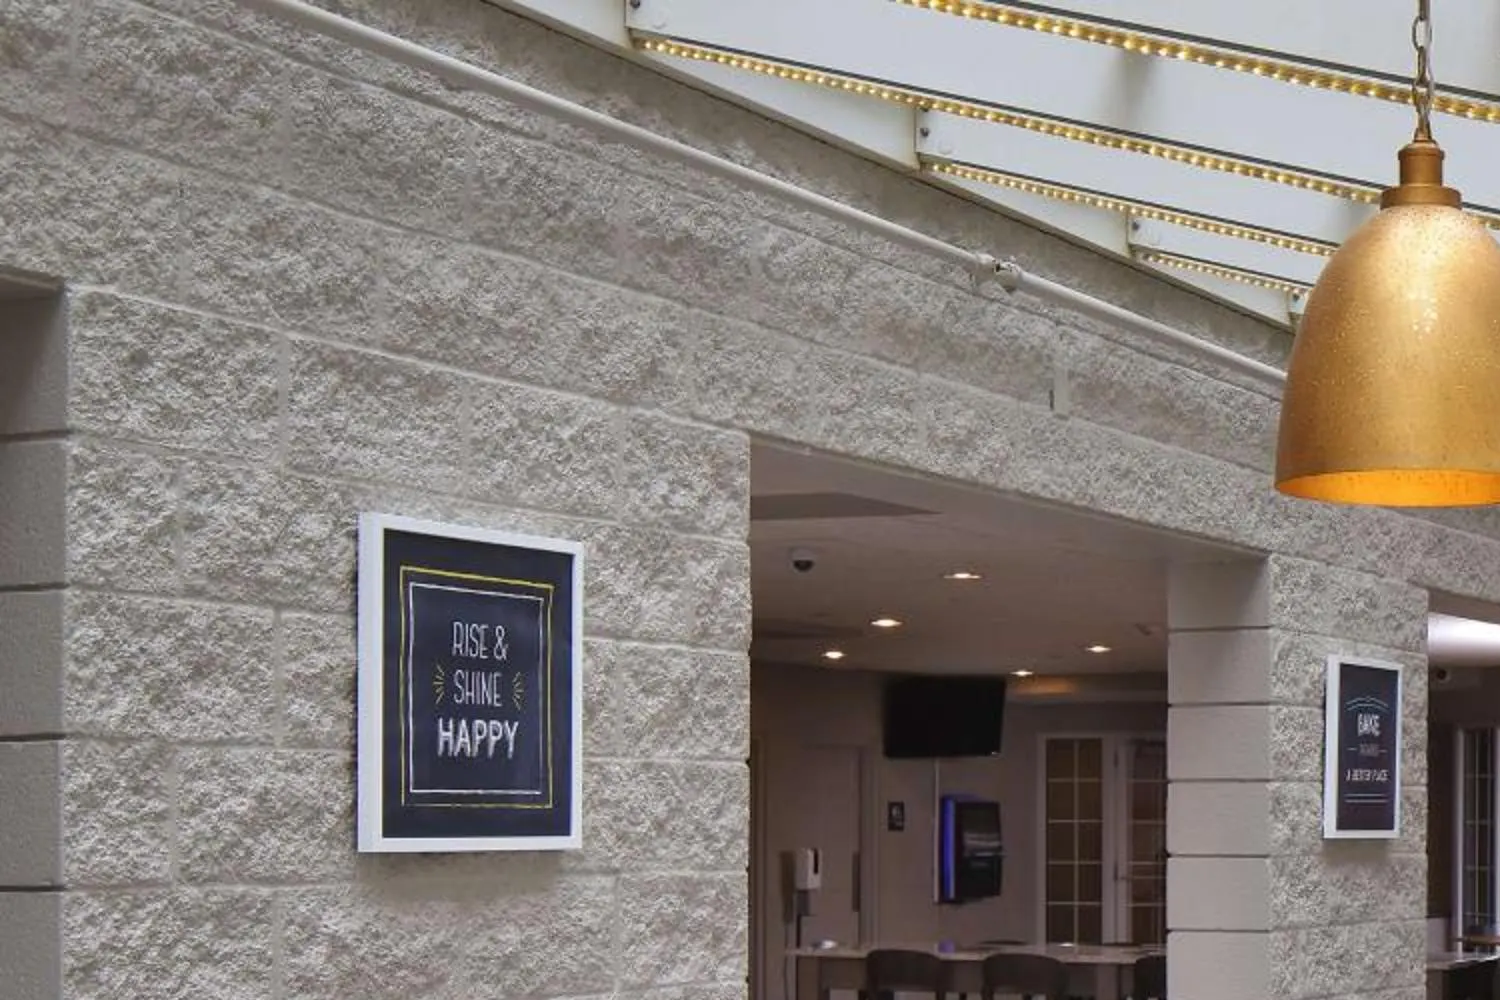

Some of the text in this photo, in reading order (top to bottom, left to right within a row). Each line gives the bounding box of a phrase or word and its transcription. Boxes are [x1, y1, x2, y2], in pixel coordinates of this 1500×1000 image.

[452, 621, 509, 661] RISE &
[454, 669, 503, 707] SHINE
[437, 717, 519, 760] HAPPY
